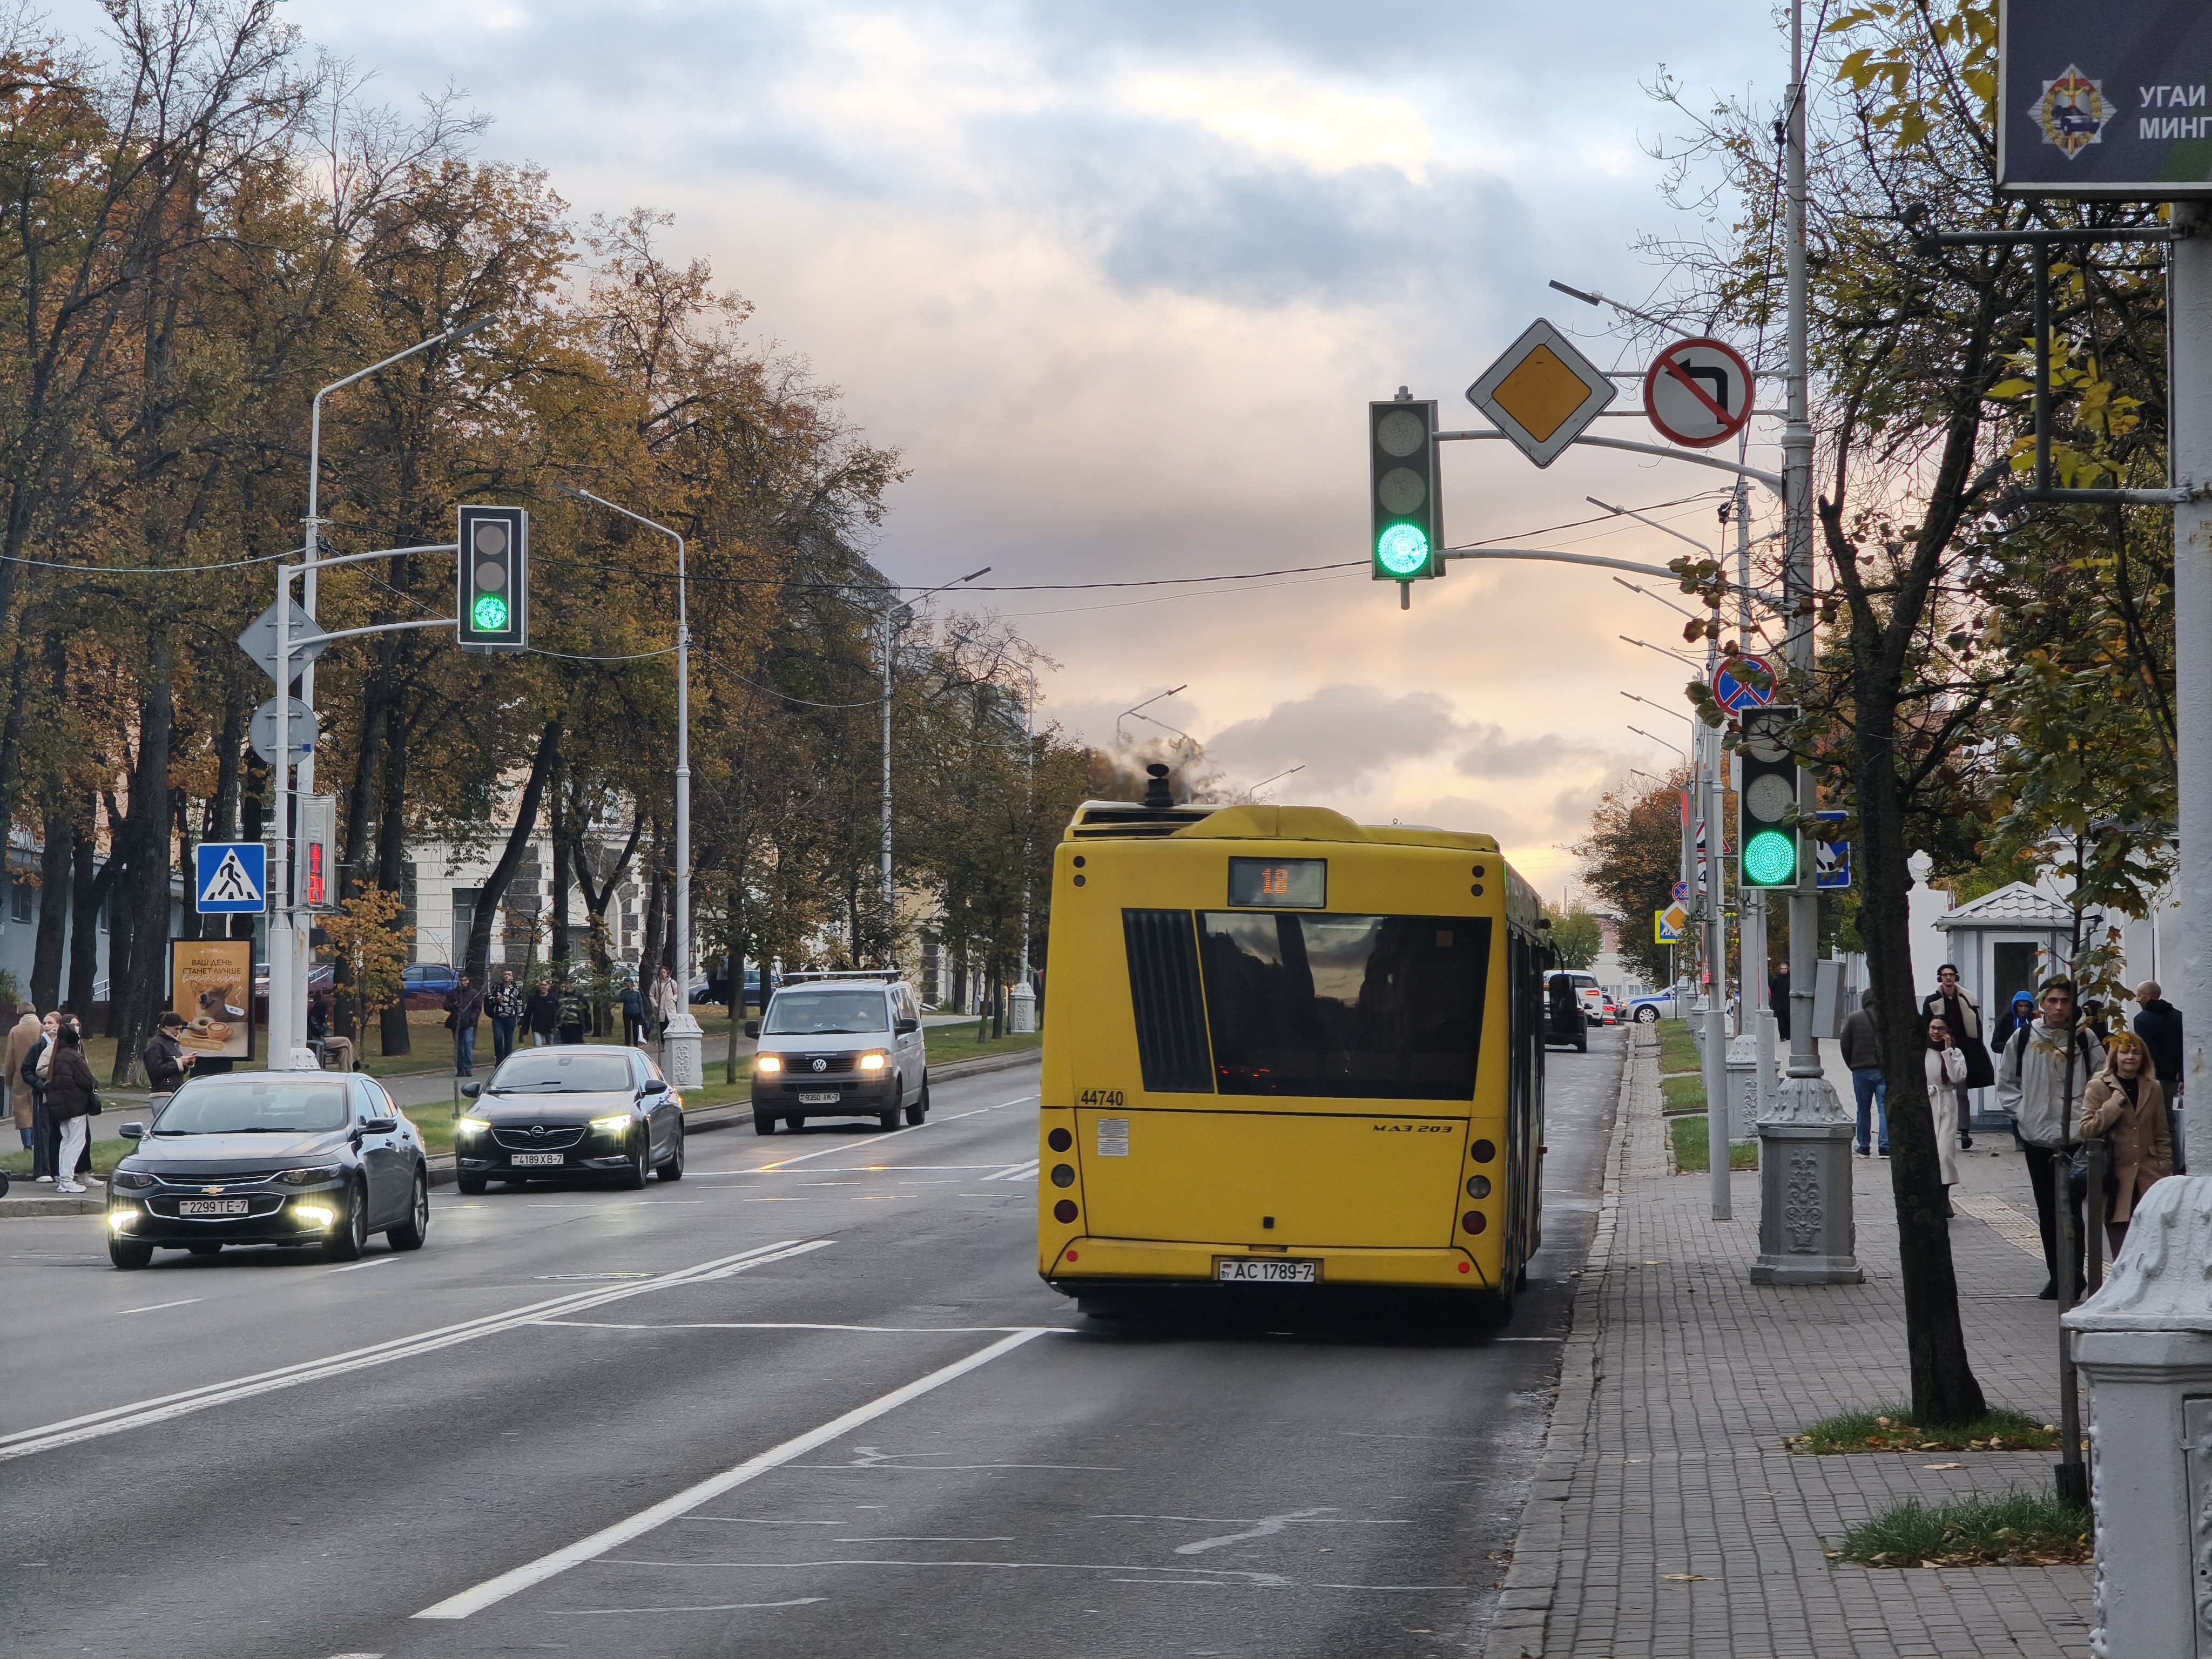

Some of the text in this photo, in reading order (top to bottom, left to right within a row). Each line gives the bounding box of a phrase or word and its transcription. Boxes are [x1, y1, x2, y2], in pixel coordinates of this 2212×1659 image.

[2140, 85, 2206, 107] УГАИ
[2140, 117, 2212, 139] МИНГ
[1262, 868, 1288, 894] 18
[211, 959, 232, 967] ДЕНЬ
[1081, 1090, 1124, 1106] 44740
[519, 1155, 563, 1164] 4189 XB-7
[190, 1201, 247, 1213] 2299 TE-7
[1234, 1263, 1258, 1279] AC
[1263, 1264, 1312, 1280] 1789-7
